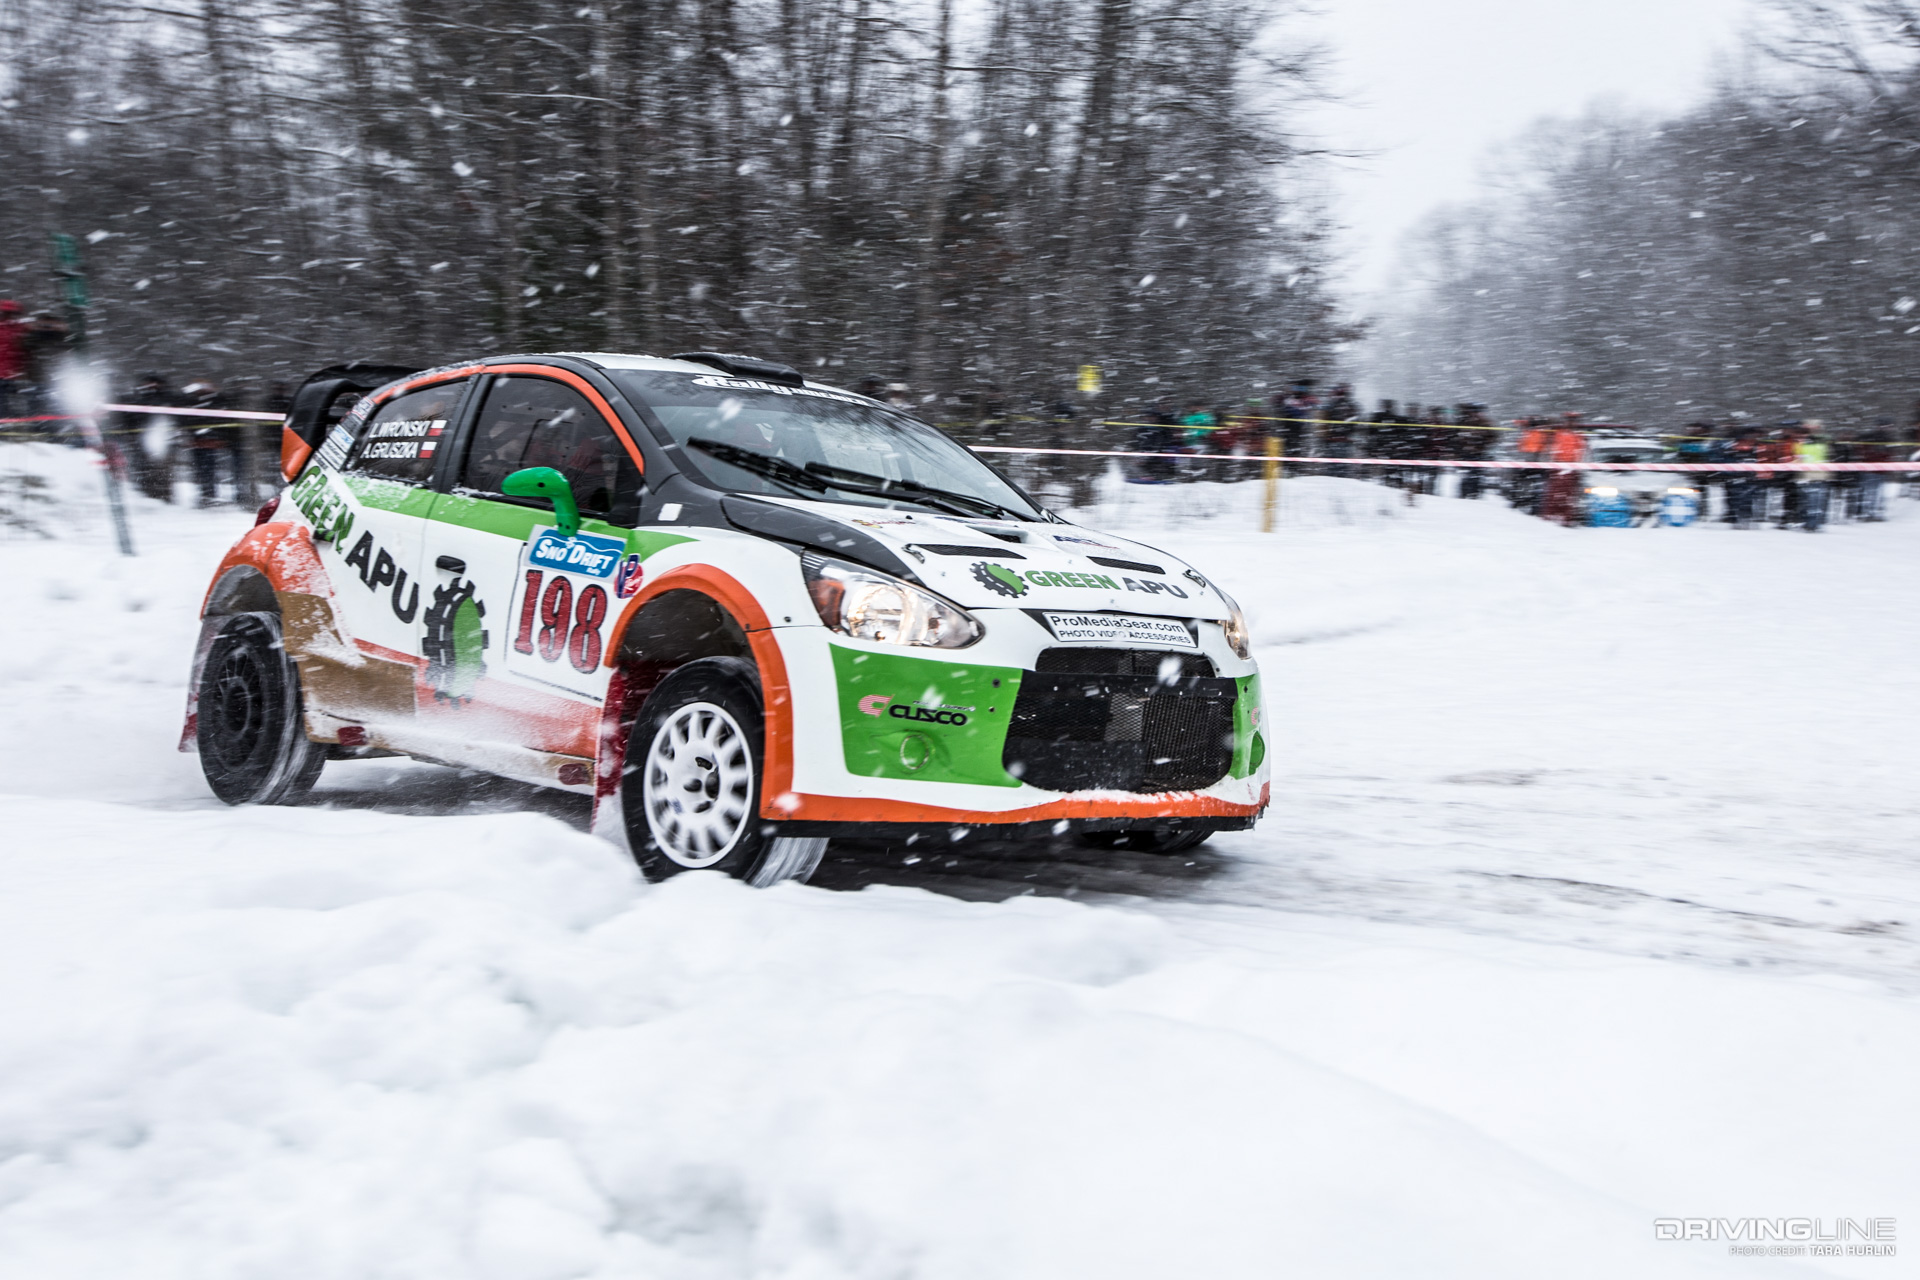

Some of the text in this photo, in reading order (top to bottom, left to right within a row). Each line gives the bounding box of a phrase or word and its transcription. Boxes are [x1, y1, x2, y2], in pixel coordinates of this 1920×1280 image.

[291, 465, 355, 555] GREEN
[345, 530, 419, 624] APU
[1024, 570, 1189, 599] GREEN APU
[514, 569, 608, 674] 198
[1050, 615, 1185, 634] ProMediaGear.com
[1058, 630, 1095, 639] PHOTO
[1129, 632, 1191, 644] ACCESSORIES
[889, 704, 968, 727] CUSCO
